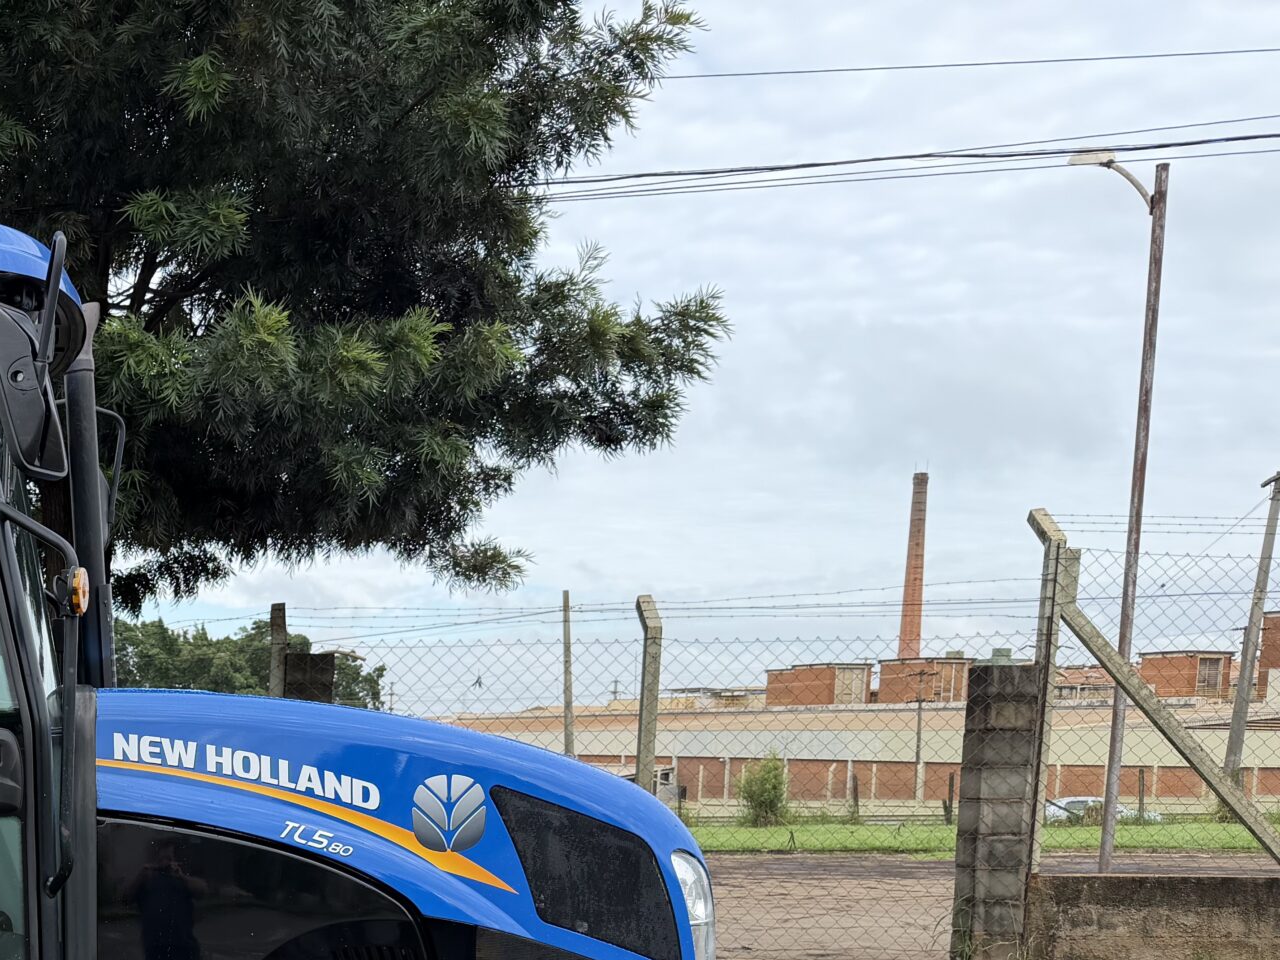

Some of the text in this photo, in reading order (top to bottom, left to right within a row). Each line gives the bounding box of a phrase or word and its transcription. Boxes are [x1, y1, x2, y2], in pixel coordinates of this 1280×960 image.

[113, 732, 381, 811] NEW HOLLAND
[280, 821, 354, 857] TL5.80
